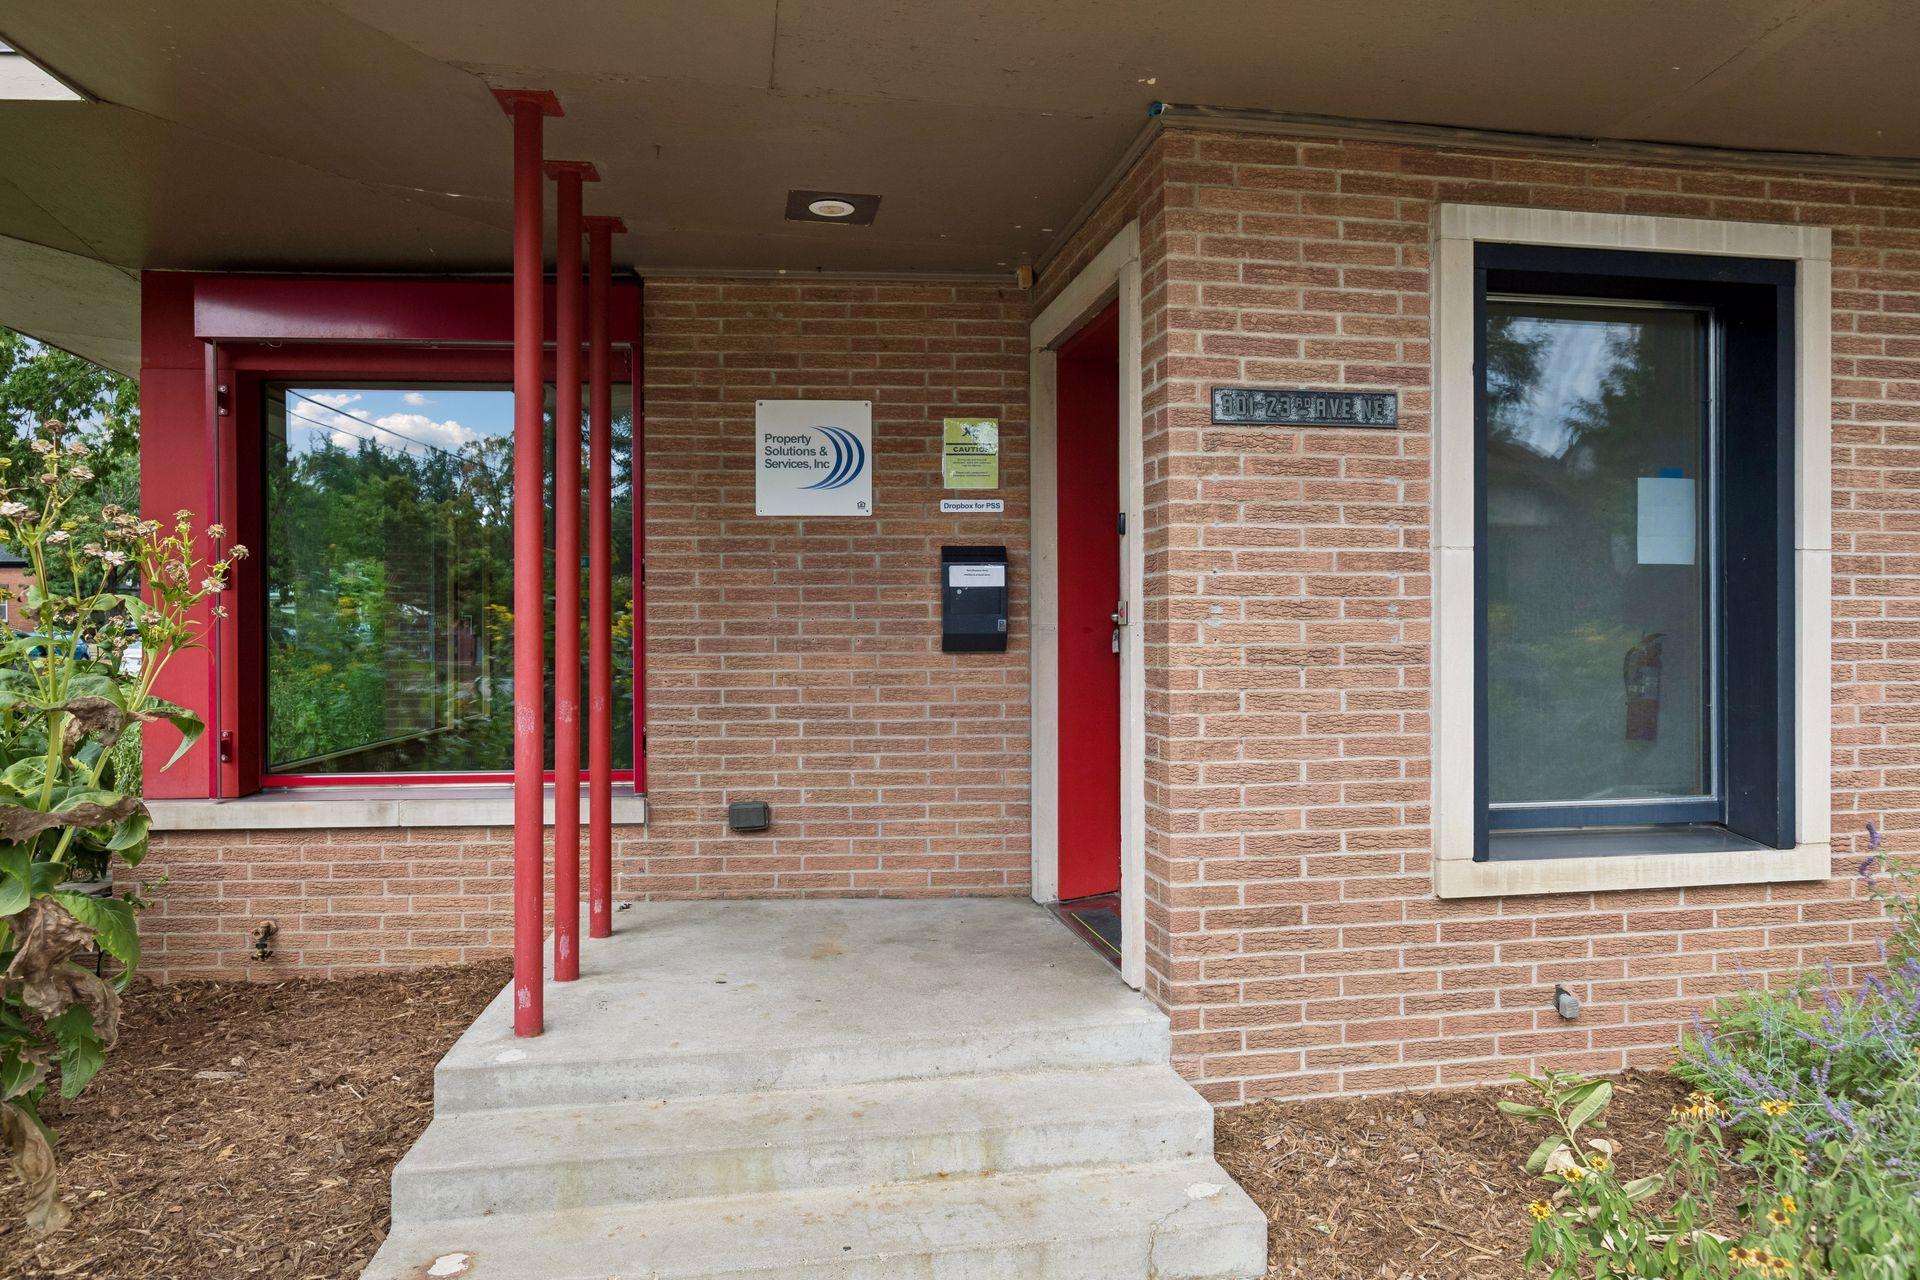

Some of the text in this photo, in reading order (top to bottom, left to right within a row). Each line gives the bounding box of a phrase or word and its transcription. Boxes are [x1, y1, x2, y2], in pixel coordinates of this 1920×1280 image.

[1315, 397, 1351, 418] AVE
[1360, 399, 1384, 420] NE
[764, 433, 812, 445] Property
[764, 446, 828, 456] Solutions &
[764, 459, 830, 470] Services, Inc
[943, 502, 973, 510] Dropbox
